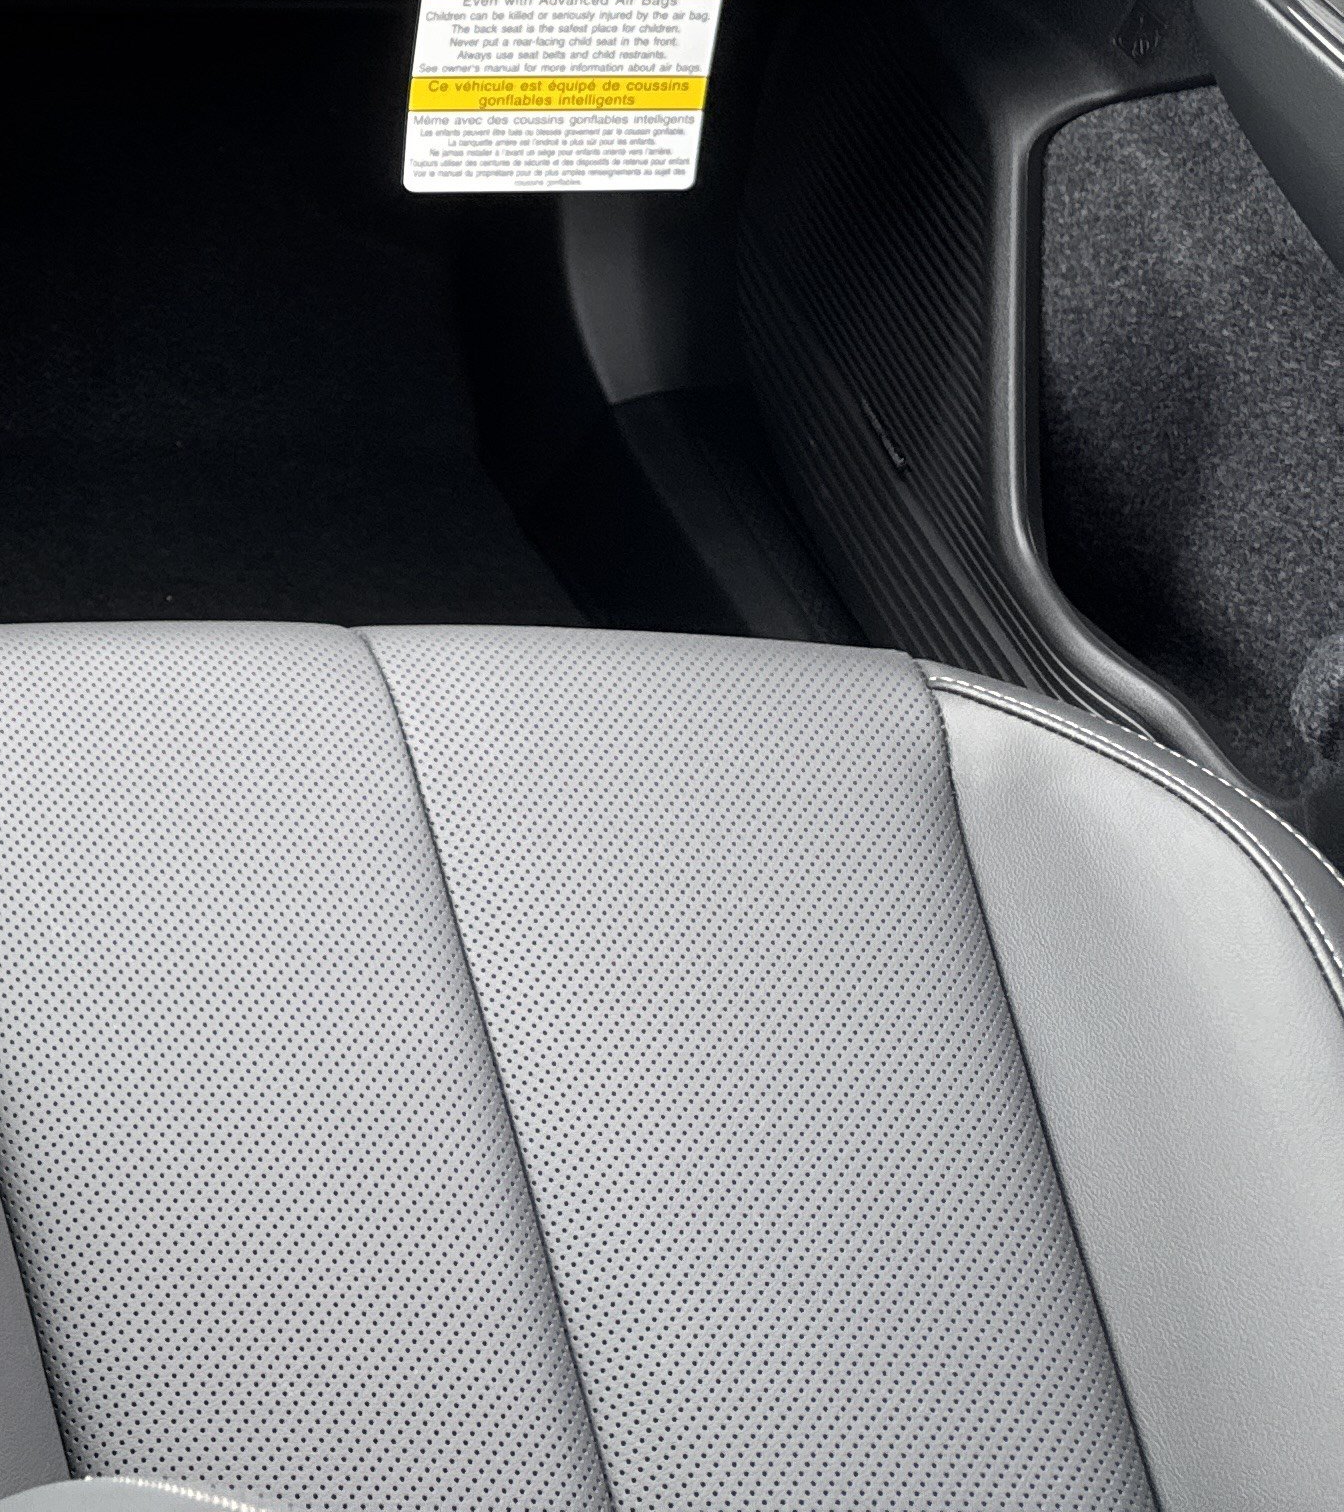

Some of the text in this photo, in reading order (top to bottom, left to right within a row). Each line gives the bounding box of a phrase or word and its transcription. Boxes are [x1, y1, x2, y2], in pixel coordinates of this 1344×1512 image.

[425, 10, 711, 22] Children can be killed or seriously injured by the air bag.
[452, 23, 681, 35] The back seat is the safest place for children.
[428, 78, 690, 93] Ce véhicule est équipé de coussins
[478, 94, 635, 109] gonflables intelligents
[413, 114, 695, 127] Même avec des coussins gonflables intelligents
